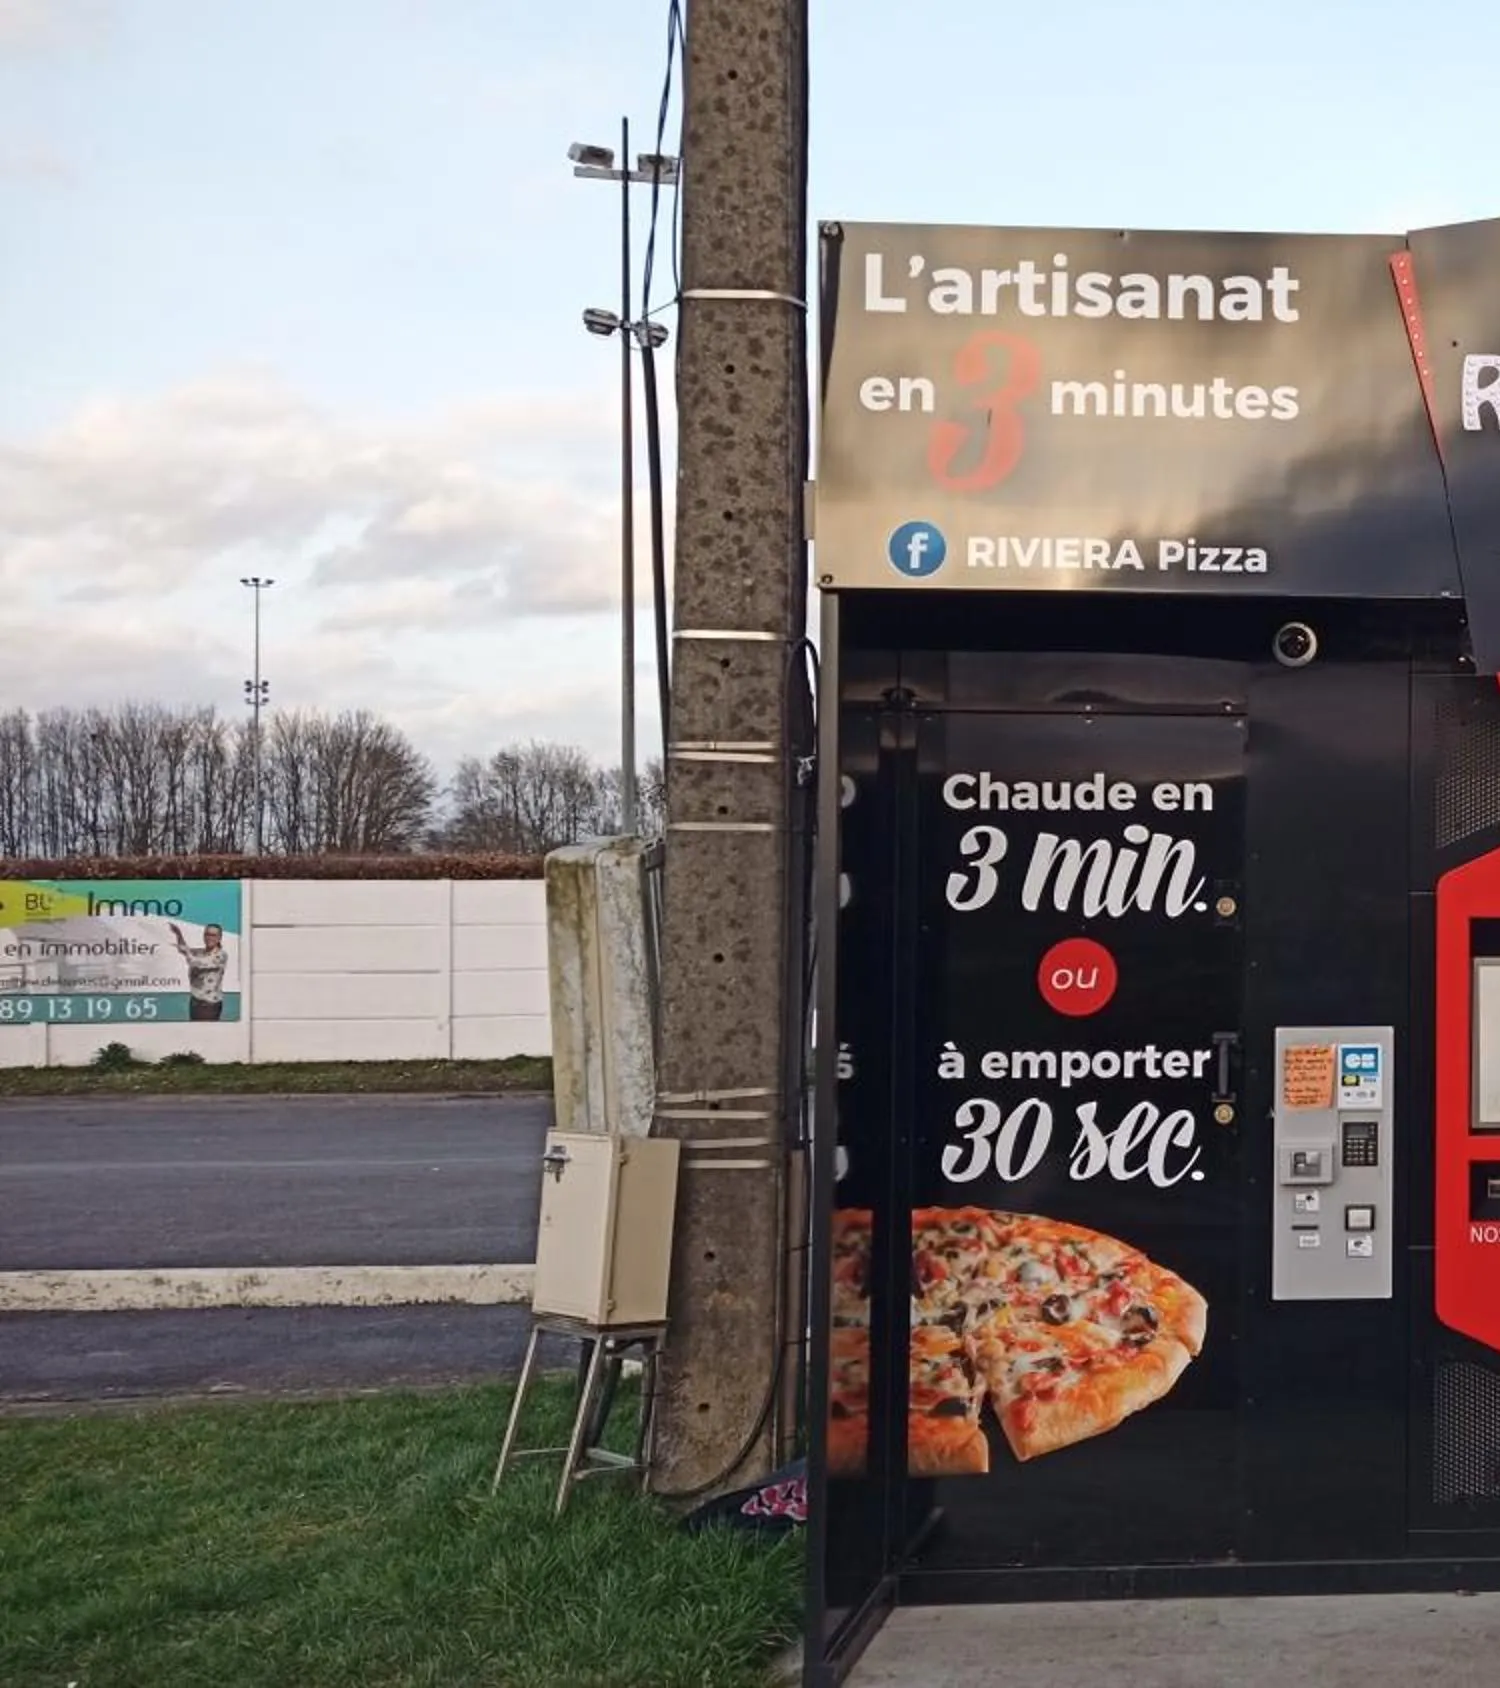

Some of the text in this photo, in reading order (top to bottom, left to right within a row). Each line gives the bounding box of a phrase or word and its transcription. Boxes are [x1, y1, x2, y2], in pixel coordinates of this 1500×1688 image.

[859, 329, 1299, 492] en 3 minutes
[967, 537, 1144, 570] RIVIERA
[1158, 539, 1268, 574] Pizza
[942, 772, 1213, 812] Chaude en
[945, 824, 1208, 918] 3 min.
[87, 892, 183, 917] Immo
[41, 938, 157, 956] immobilier
[1051, 967, 1099, 989] ou
[48, 998, 72, 1019] 13
[87, 998, 112, 1019] 19
[126, 998, 158, 1018] 65
[938, 1042, 1212, 1087] à emporter
[941, 1098, 1205, 1188] 30 sec.
